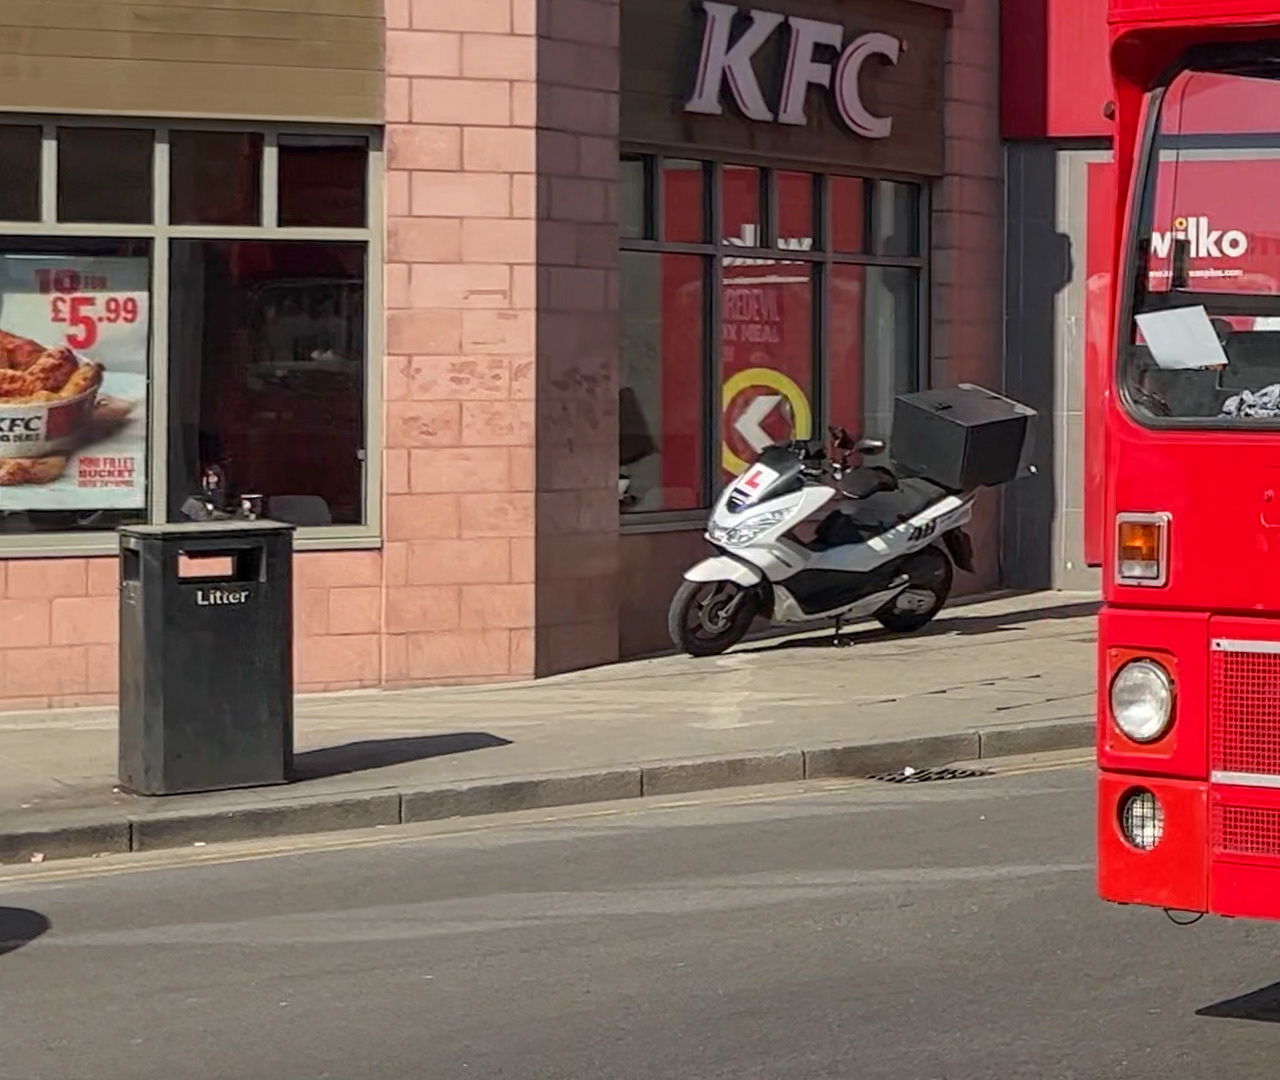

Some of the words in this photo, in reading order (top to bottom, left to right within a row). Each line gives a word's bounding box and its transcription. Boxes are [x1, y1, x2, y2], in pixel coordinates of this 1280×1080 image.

[684, 0, 900, 138] KFC
[51, 296, 138, 350] £5.99
[744, 470, 762, 490] L
[197, 589, 249, 606] Litter
